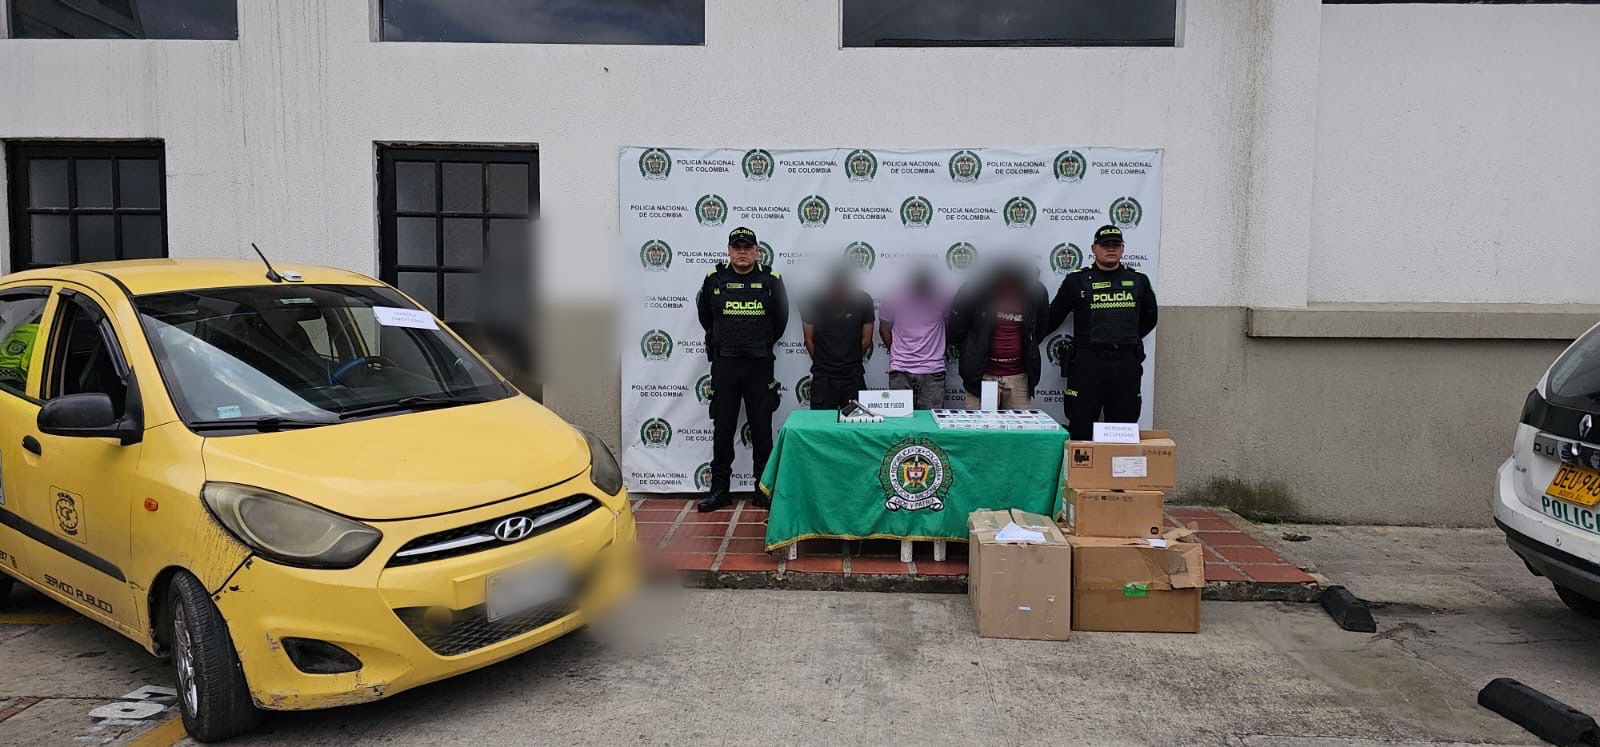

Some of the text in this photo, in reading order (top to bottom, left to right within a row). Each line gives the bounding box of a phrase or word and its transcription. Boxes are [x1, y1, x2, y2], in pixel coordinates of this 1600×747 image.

[702, 159, 736, 167] NACIONAL
[805, 160, 838, 168] NACIONAL
[883, 160, 909, 168] POLICIA
[656, 204, 689, 212] NACIONAL
[964, 207, 997, 215] NACIONAL
[1061, 214, 1095, 222] COLOMBIA
[1093, 290, 1134, 302] POLICÍA
[725, 299, 763, 309] POLICÍA
